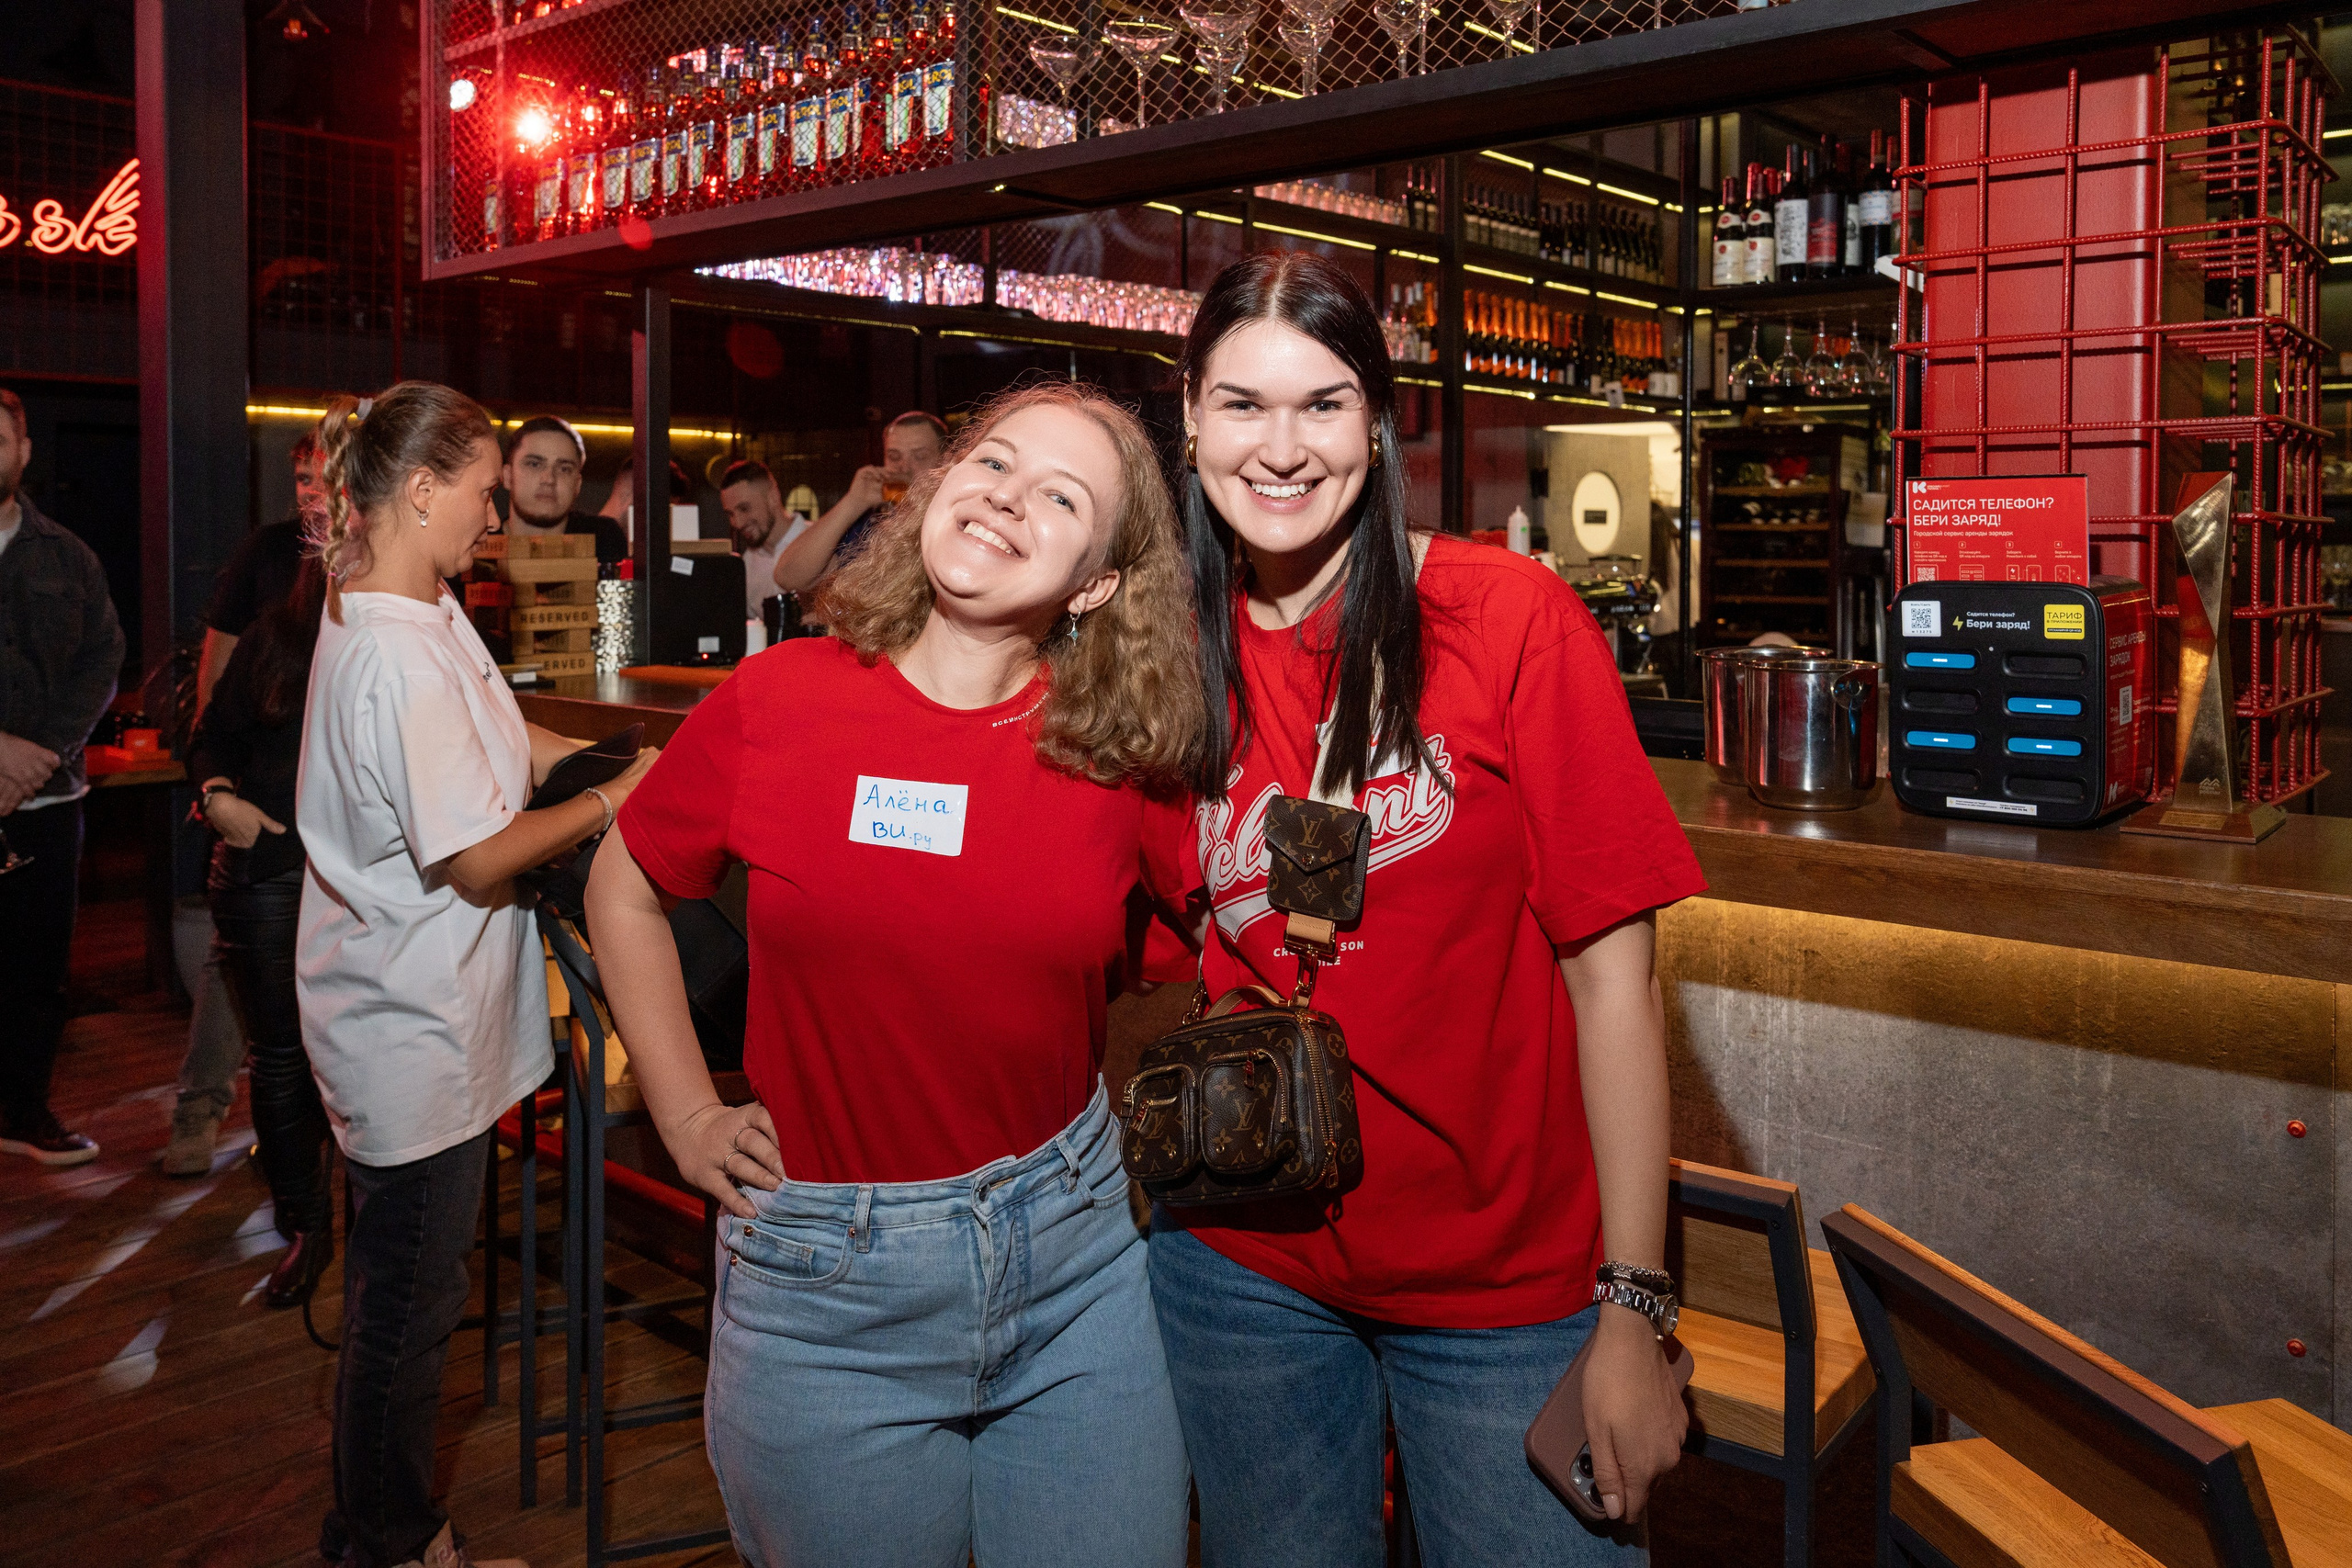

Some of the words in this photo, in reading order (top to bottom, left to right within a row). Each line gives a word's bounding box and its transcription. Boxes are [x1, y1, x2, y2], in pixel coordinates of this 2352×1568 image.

[1913, 499, 1975, 512] САДИТСЯ
[1979, 497, 2054, 510] ТЕЛЕФОН?
[1914, 514, 1948, 525] БЕРИ
[1951, 514, 2001, 527] ЗАРЯД!
[520, 611, 589, 625] RESERVED
[1966, 619, 1993, 630] Бери
[1996, 620, 2030, 631] заряд!
[544, 658, 586, 671] ERVED
[863, 784, 950, 814] Алёна
